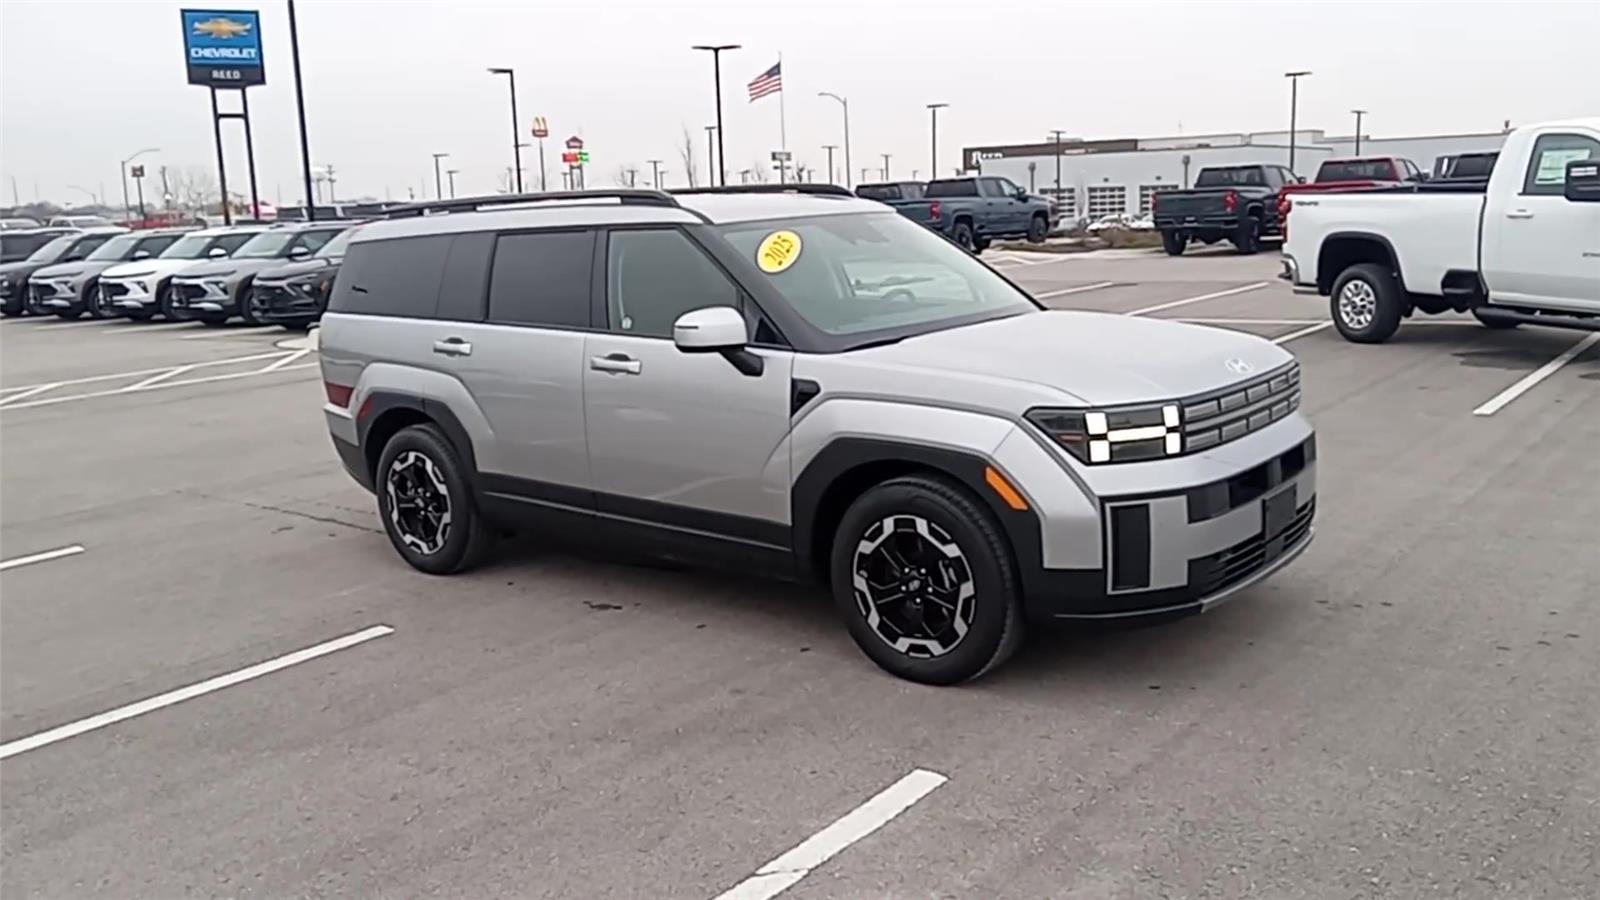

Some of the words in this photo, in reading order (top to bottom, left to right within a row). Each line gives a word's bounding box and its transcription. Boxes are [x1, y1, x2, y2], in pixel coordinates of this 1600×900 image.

[190, 47, 257, 58] CHEVROLET
[212, 69, 241, 79] REED
[764, 234, 794, 267] 2025
